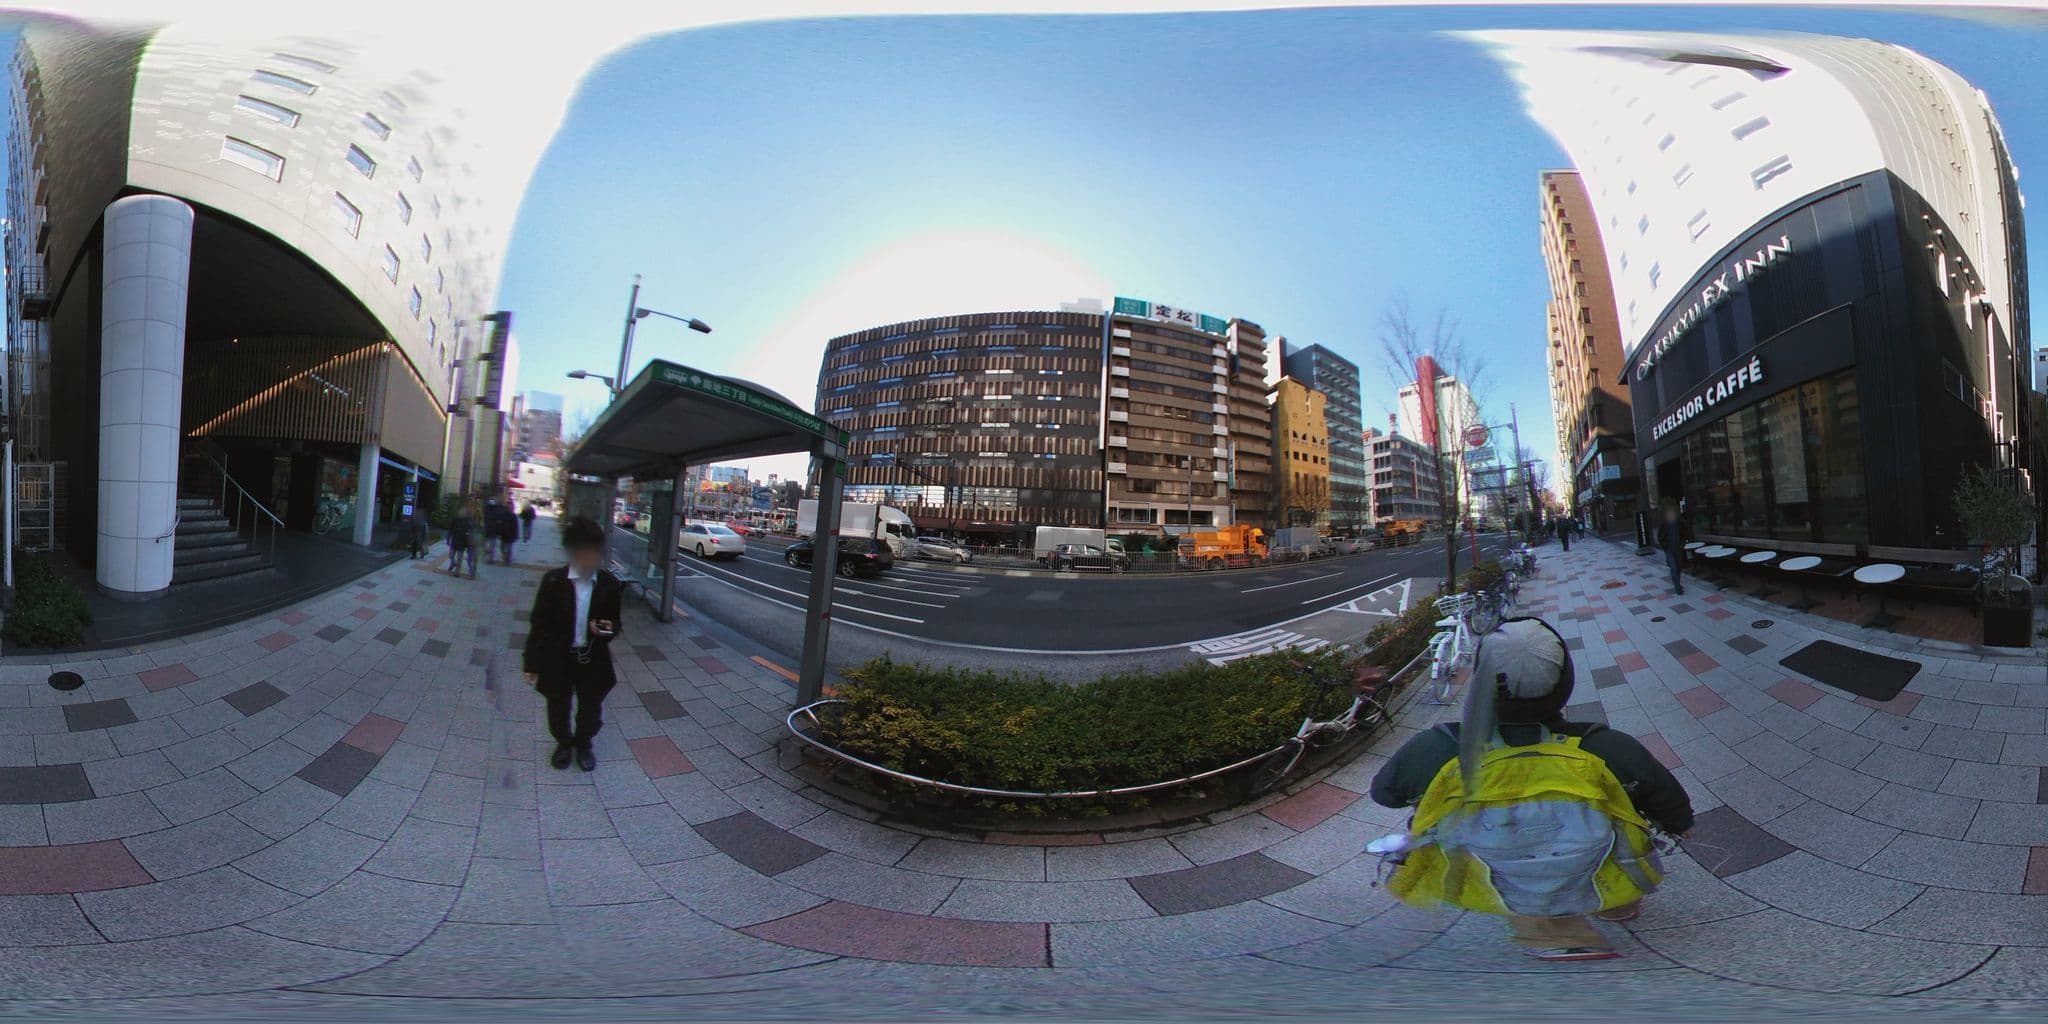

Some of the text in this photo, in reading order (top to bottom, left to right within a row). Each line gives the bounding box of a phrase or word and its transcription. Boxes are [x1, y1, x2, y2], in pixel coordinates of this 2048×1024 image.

[1155, 304, 1194, 323] 定松
[1654, 303, 1702, 360] KEIKYU
[1701, 272, 1730, 309] EX
[1733, 234, 1793, 283] INN
[1653, 355, 1763, 441] EXCELSIOR CAFFÉ
